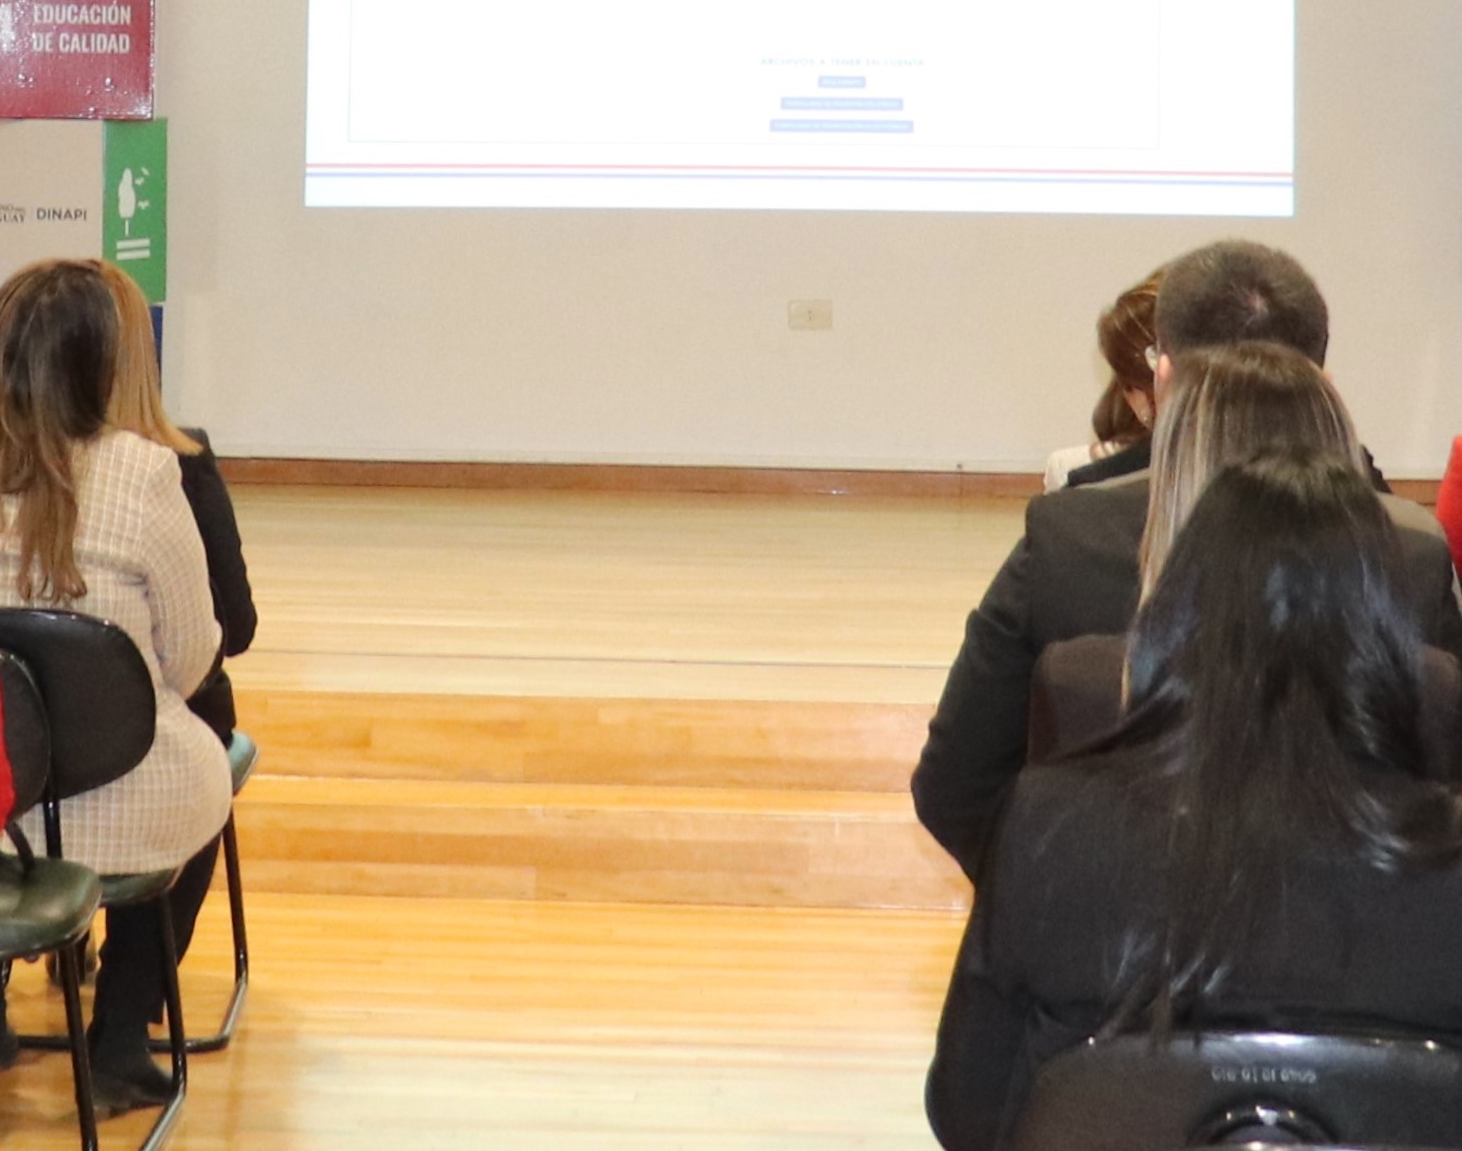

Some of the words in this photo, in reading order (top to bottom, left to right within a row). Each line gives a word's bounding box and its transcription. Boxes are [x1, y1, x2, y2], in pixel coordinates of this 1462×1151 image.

[33, 0, 131, 25] EDUCACIÓN
[33, 32, 54, 53] DE
[59, 33, 130, 54] CALIDAD
[37, 208, 87, 221] DINAPI
